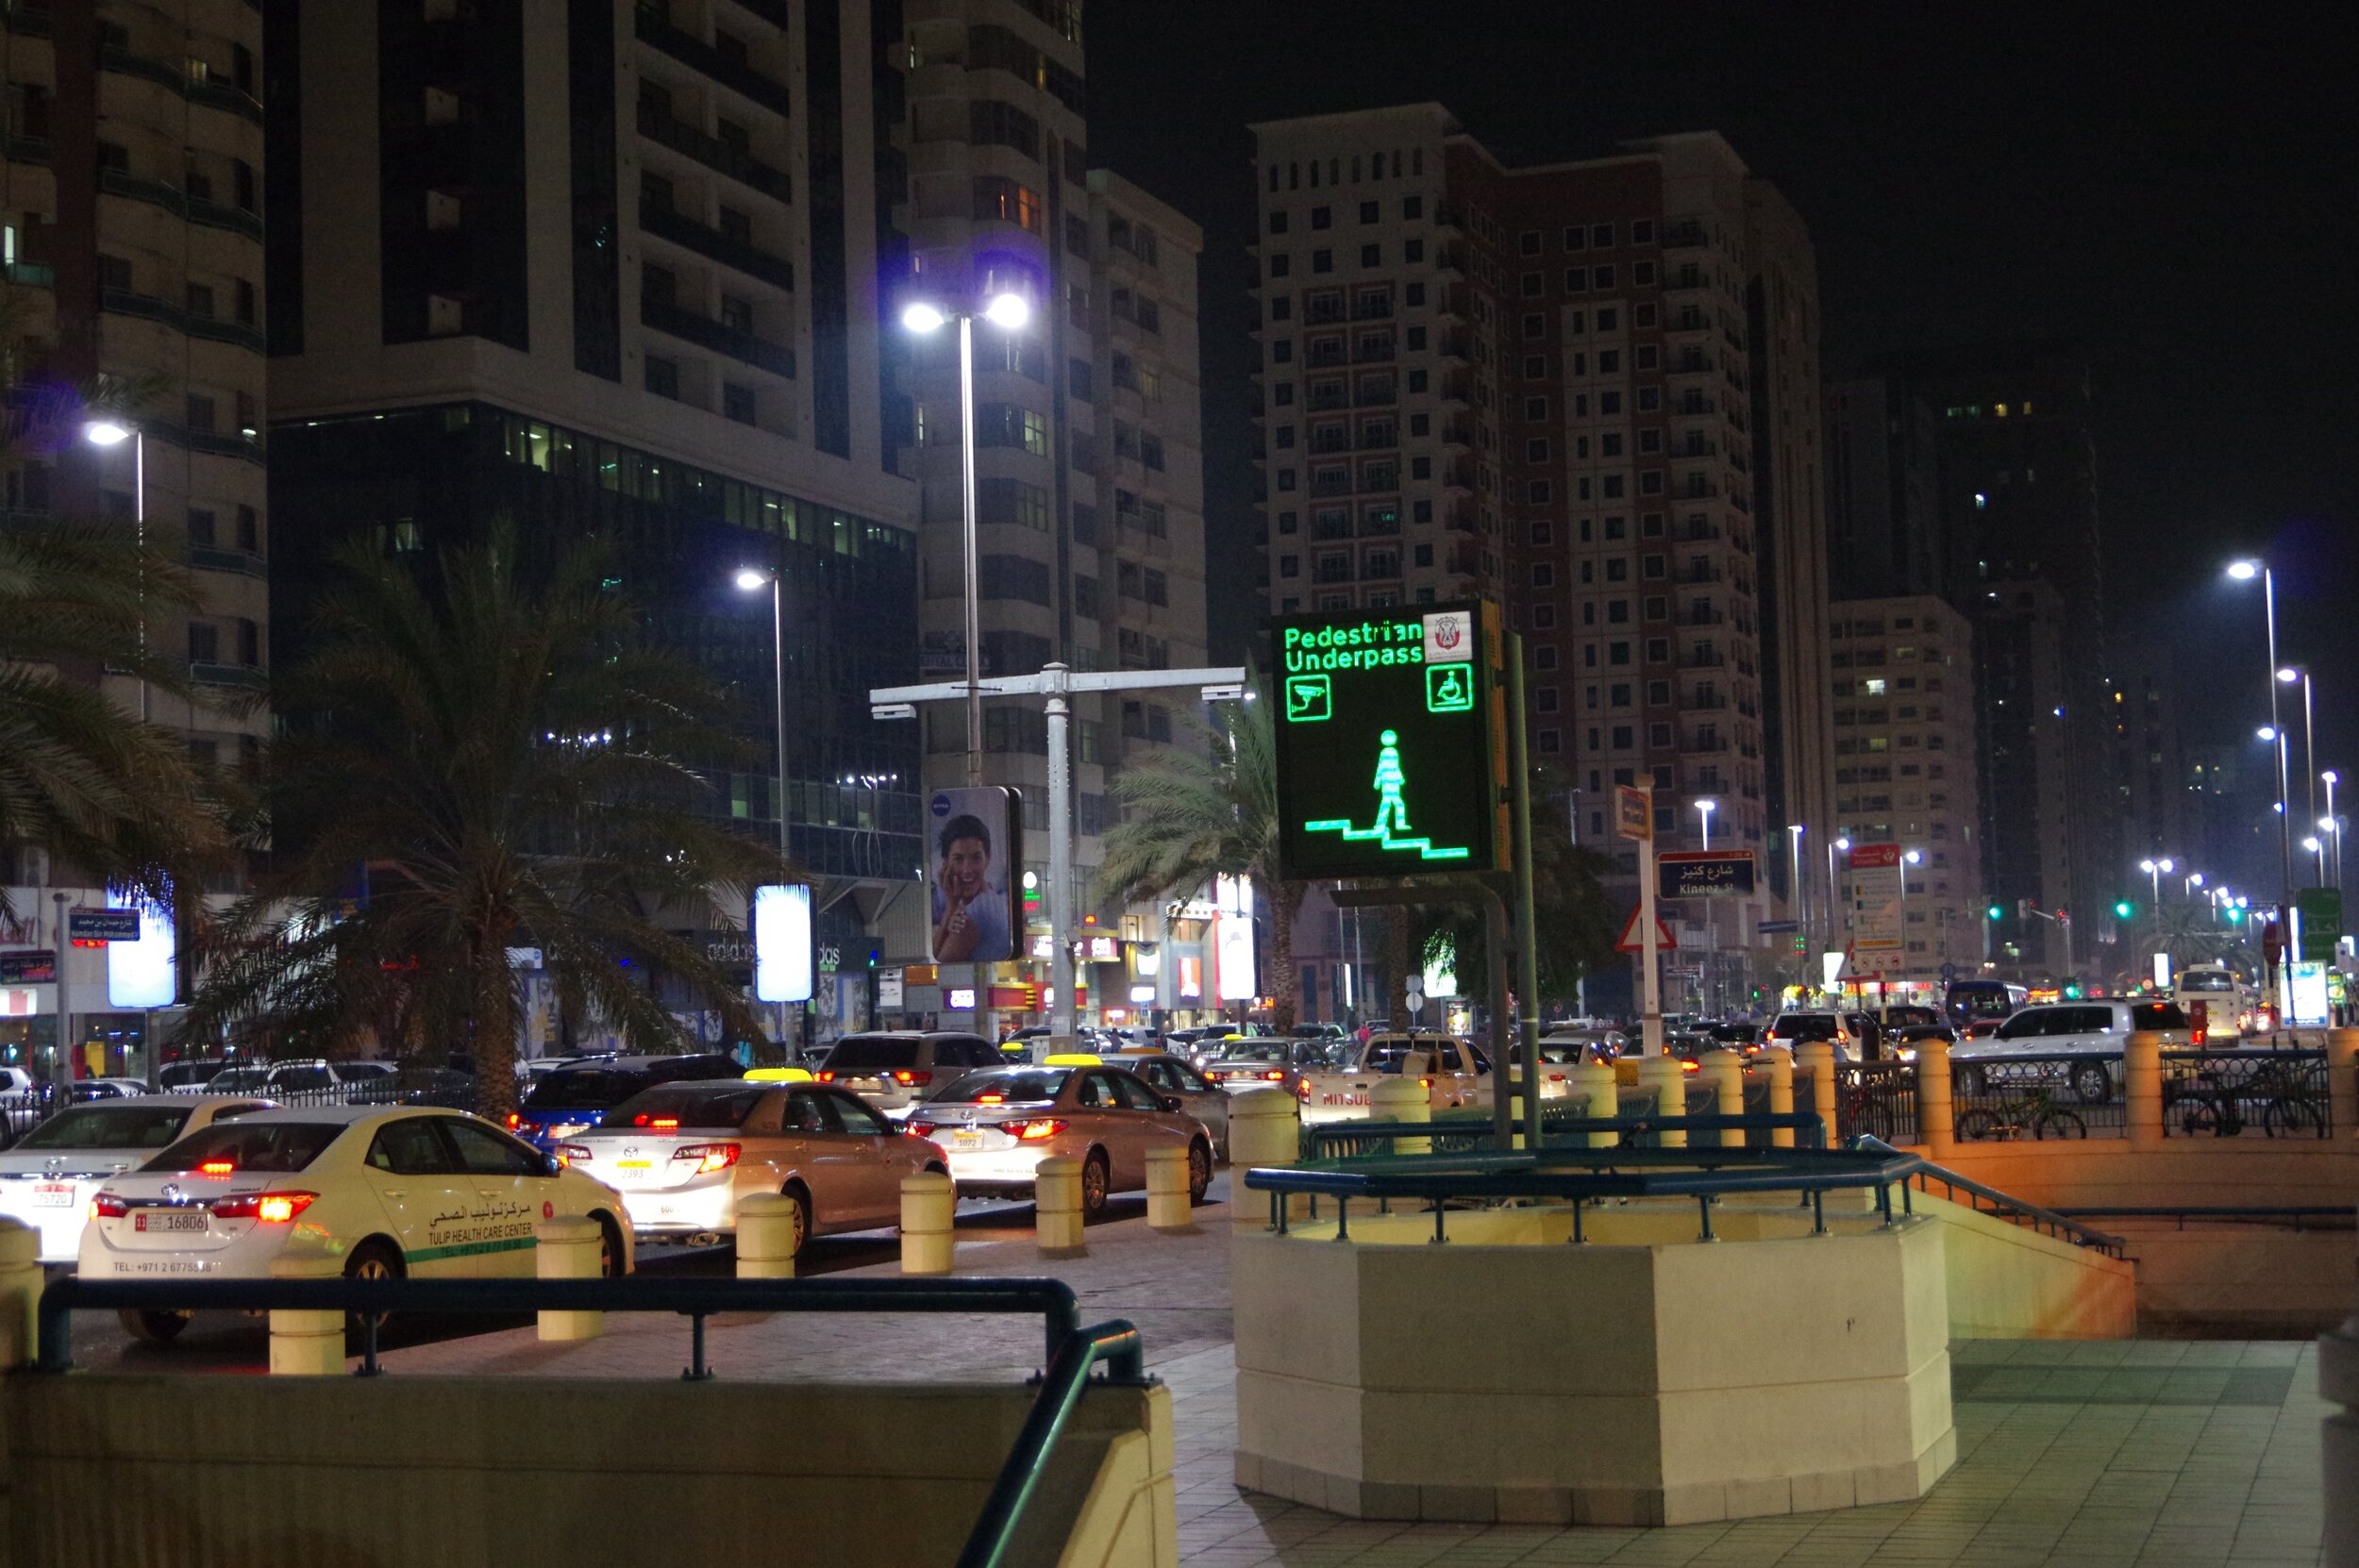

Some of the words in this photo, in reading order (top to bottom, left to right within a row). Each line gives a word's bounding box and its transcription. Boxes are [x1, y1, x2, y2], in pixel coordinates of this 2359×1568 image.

[1286, 645, 1423, 672] Underpass
[1707, 864, 1734, 881] شارع
[1680, 883, 1718, 894] Kineez
[958, 1139, 978, 1147] 1072
[621, 1169, 644, 1179] 2393
[38, 1193, 68, 1205] 75720
[430, 1204, 468, 1229] الصحي
[504, 1201, 531, 1219] مركز
[167, 1215, 205, 1228] 16806
[428, 1230, 451, 1245] TULIP
[452, 1227, 482, 1243] HEALTH
[483, 1225, 503, 1240] CARE
[504, 1222, 532, 1238] CENTER
[114, 1261, 134, 1272] TEL:
[137, 1261, 159, 1272] +971
[161, 1261, 168, 1272] 2
